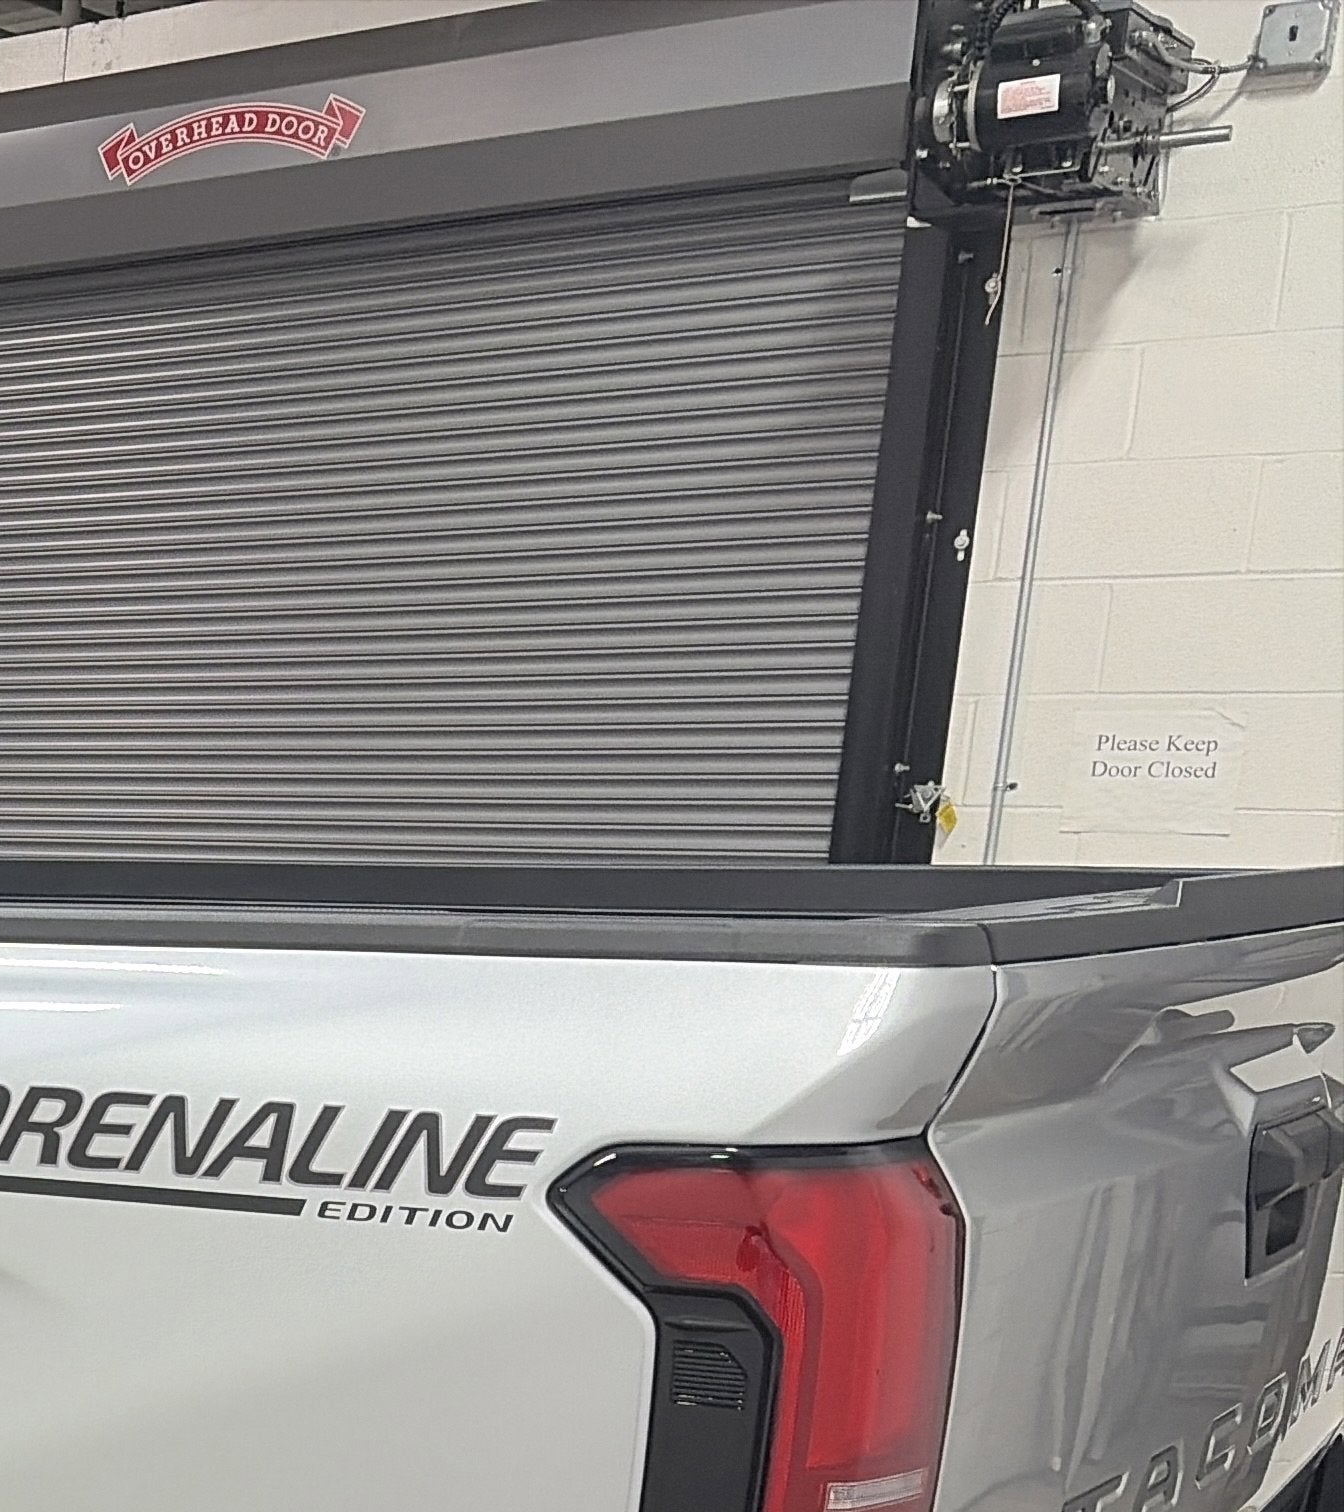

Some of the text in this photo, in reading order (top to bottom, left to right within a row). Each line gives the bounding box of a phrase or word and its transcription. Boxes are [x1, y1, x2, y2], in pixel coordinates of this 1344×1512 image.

[128, 112, 330, 170] OVERHEAD DOOR
[1096, 734, 1219, 757] Please Keep
[1091, 760, 1217, 779] Door Closed
[317, 1200, 514, 1233] EDITION
